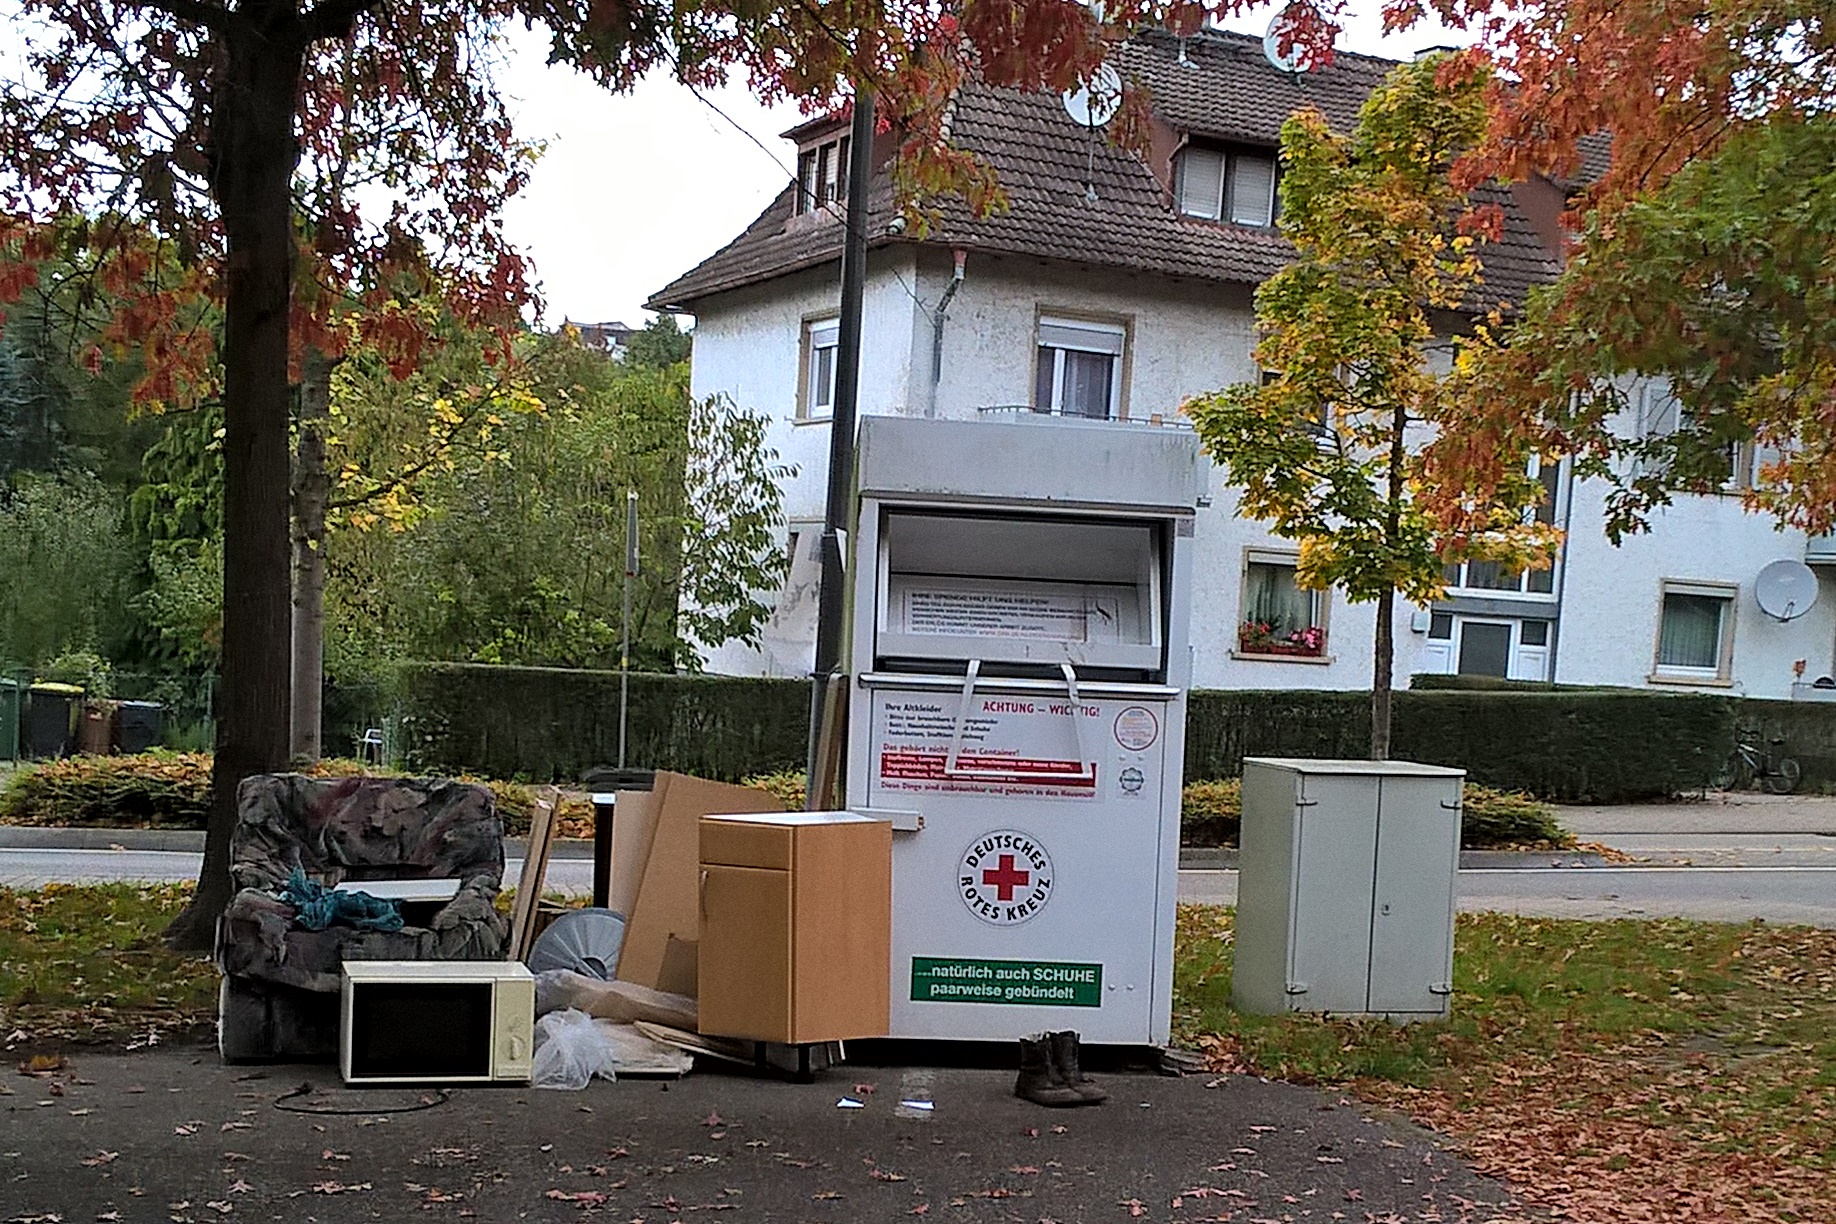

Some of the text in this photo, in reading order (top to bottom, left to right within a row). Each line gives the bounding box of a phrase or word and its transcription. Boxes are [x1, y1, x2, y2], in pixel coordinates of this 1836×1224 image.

[885, 703, 942, 713] Ihre Altkleider
[983, 701, 1034, 714] ACHTUNG
[1049, 704, 1100, 718] WICTIG!
[883, 743, 897, 751] Das
[965, 834, 1047, 871] DEUTSCHES
[960, 876, 1051, 921] ROTES KREUZ
[995, 967, 1030, 981] auch
[1032, 968, 1096, 983] SCHUHE
[930, 983, 1075, 999] paarweise gebündelt
